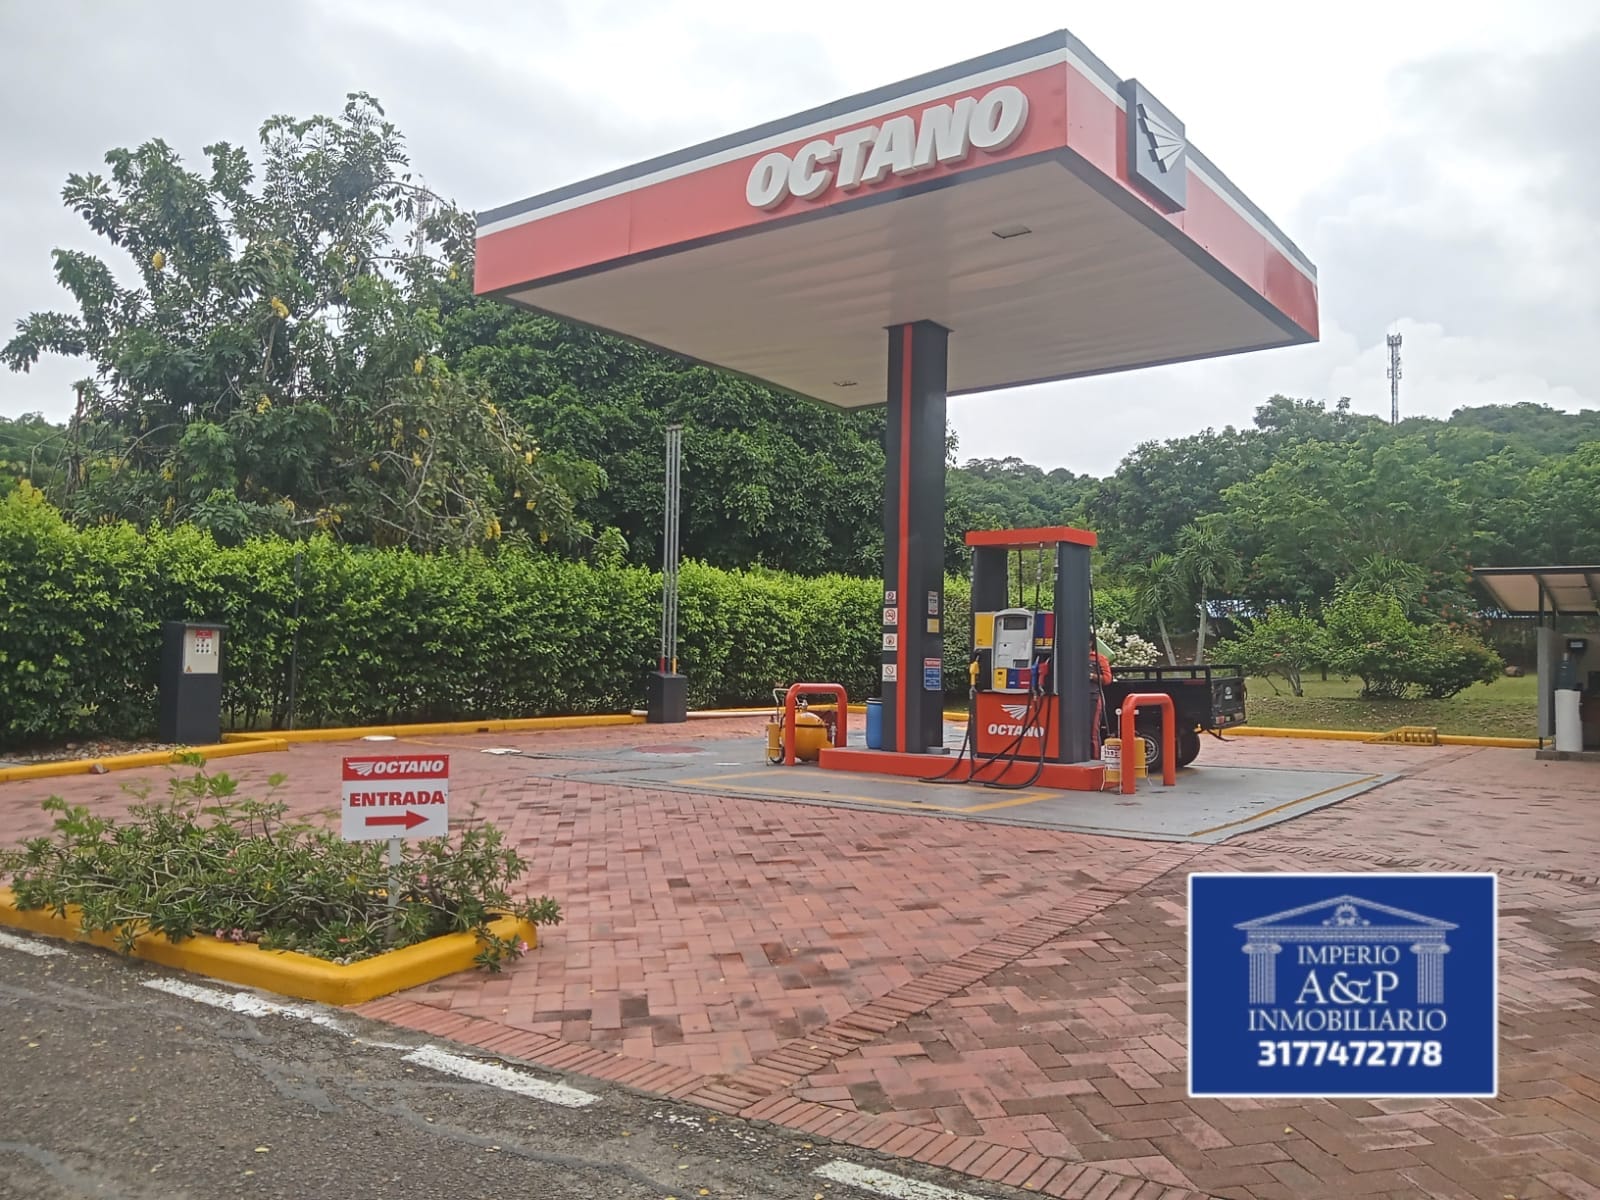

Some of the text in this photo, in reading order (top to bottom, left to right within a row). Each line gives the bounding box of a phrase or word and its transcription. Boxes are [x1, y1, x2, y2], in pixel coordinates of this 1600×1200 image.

[745, 85, 1029, 210] OCTANO
[988, 723, 1045, 738] OCTANO
[374, 760, 444, 774] OCTANO
[349, 790, 446, 807] ENTRADA
